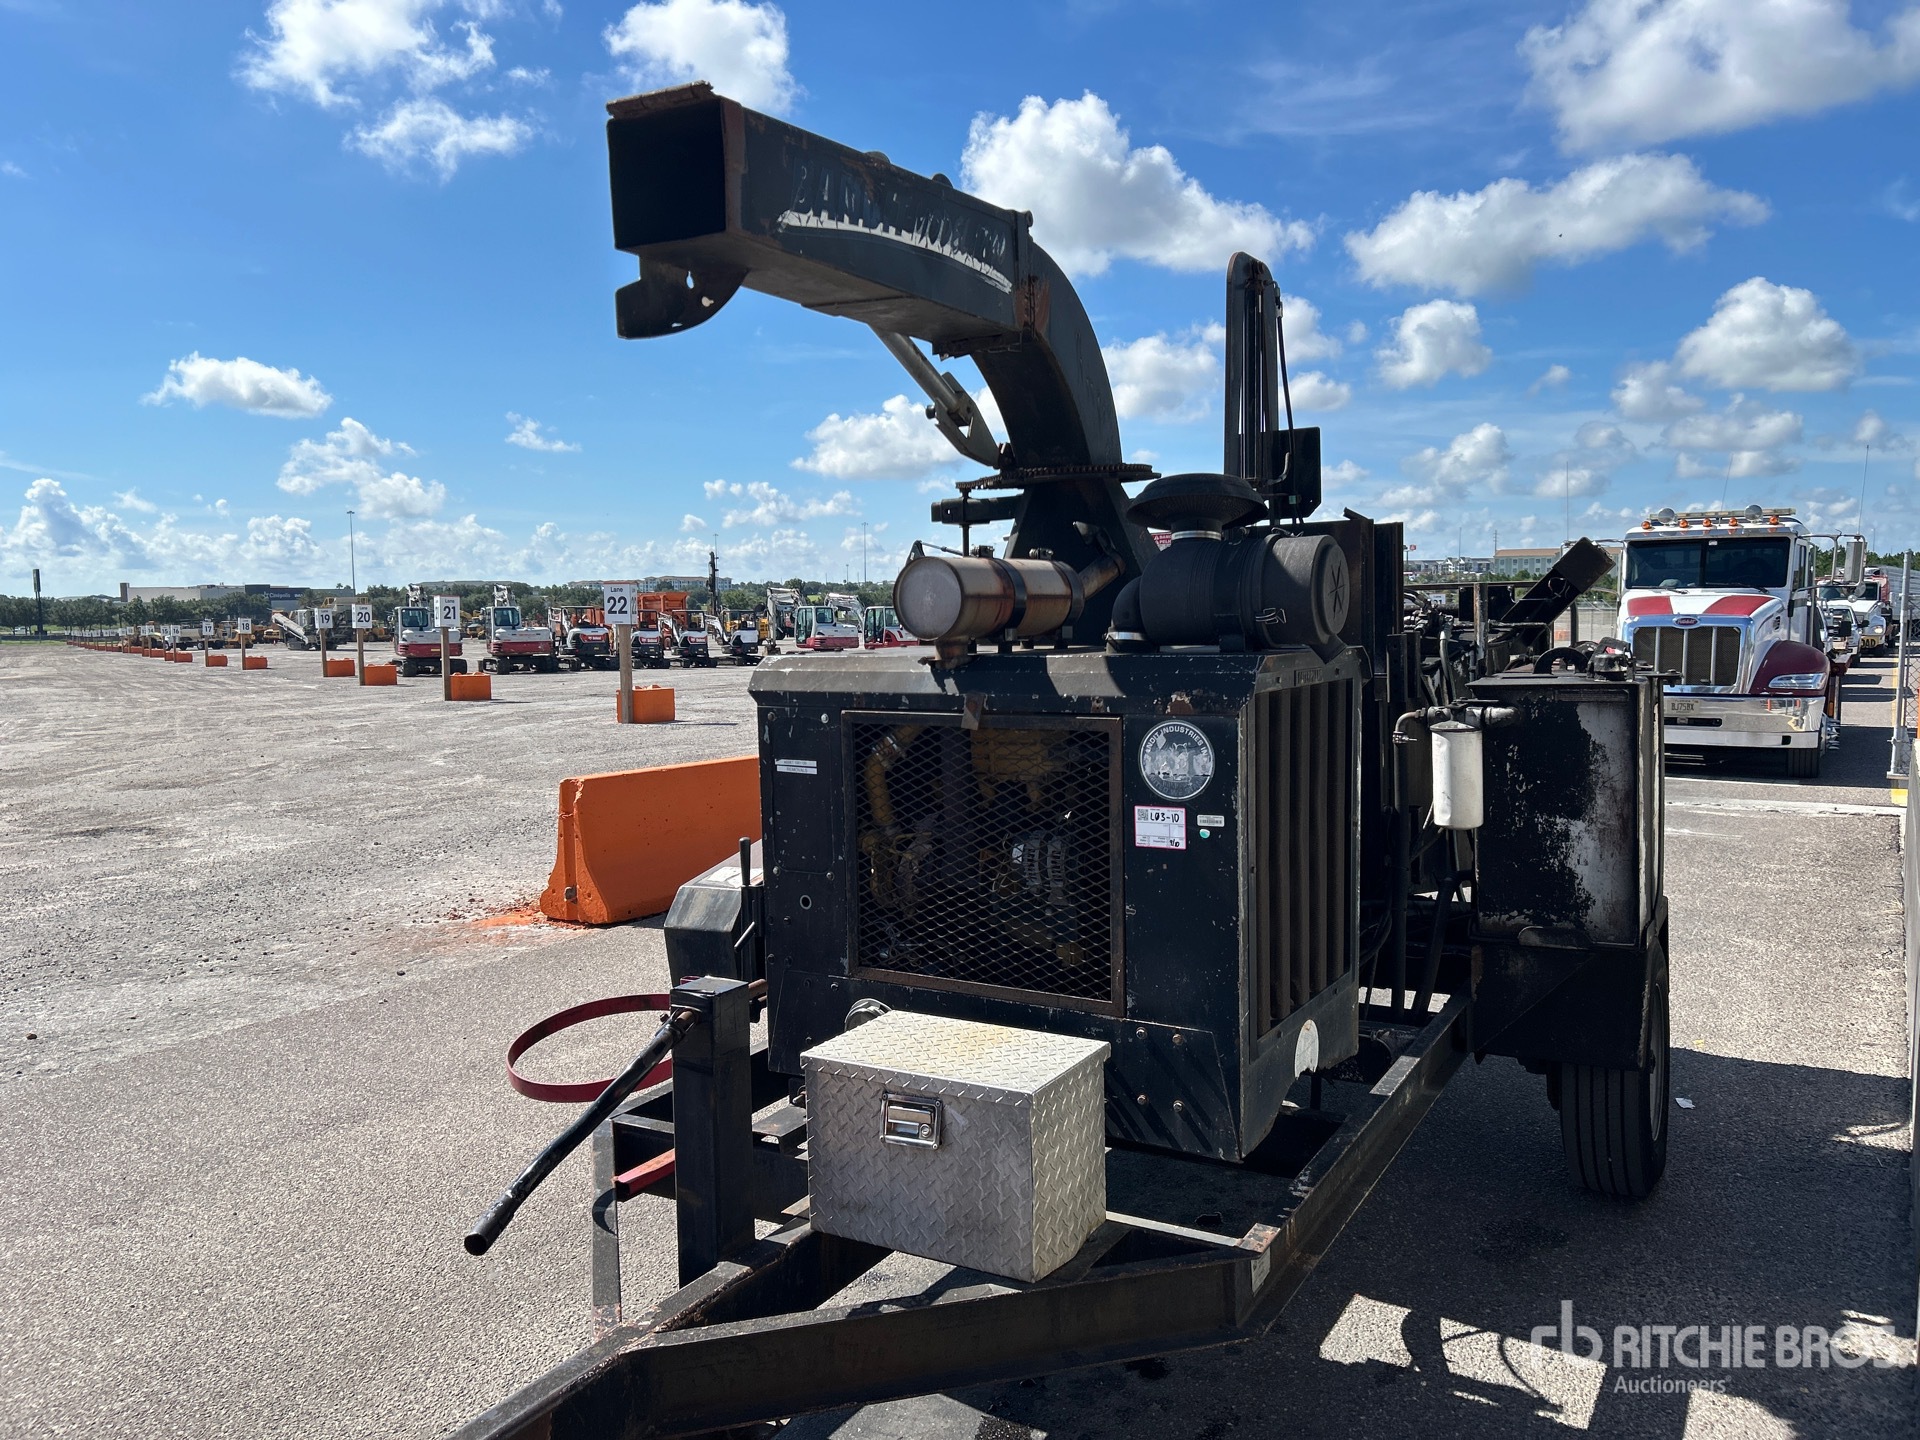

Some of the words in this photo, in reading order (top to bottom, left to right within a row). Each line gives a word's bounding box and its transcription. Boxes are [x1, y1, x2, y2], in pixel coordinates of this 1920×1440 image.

[607, 596, 628, 615] 22
[357, 612, 371, 623] 20
[443, 605, 456, 620] 21
[320, 614, 331, 624] 19
[204, 625, 212, 633] 17
[241, 622, 250, 631] 18
[1160, 725, 1205, 746] INDUSTRIES
